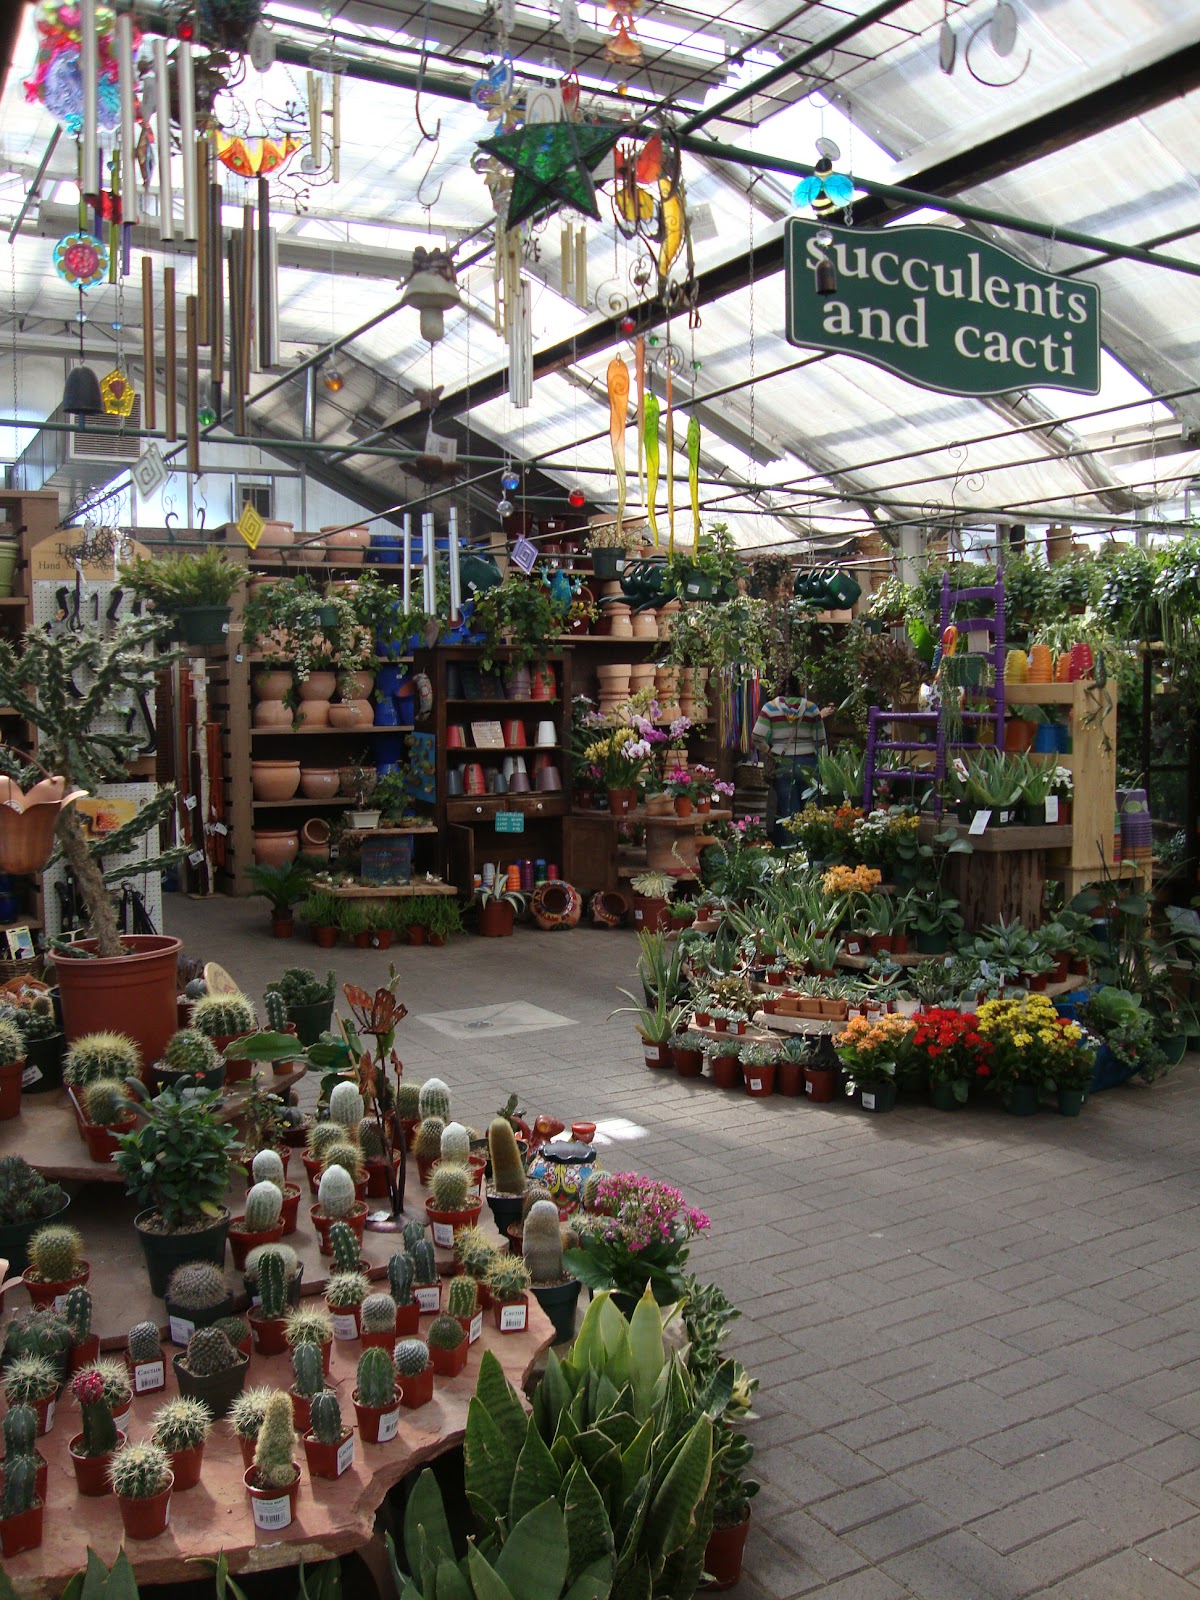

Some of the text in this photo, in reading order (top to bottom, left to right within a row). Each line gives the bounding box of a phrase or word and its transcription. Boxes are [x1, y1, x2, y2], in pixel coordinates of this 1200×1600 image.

[822, 297, 1076, 376] and cacti
[39, 561, 61, 570] Hand
[137, 1367, 161, 1376] Cactus
